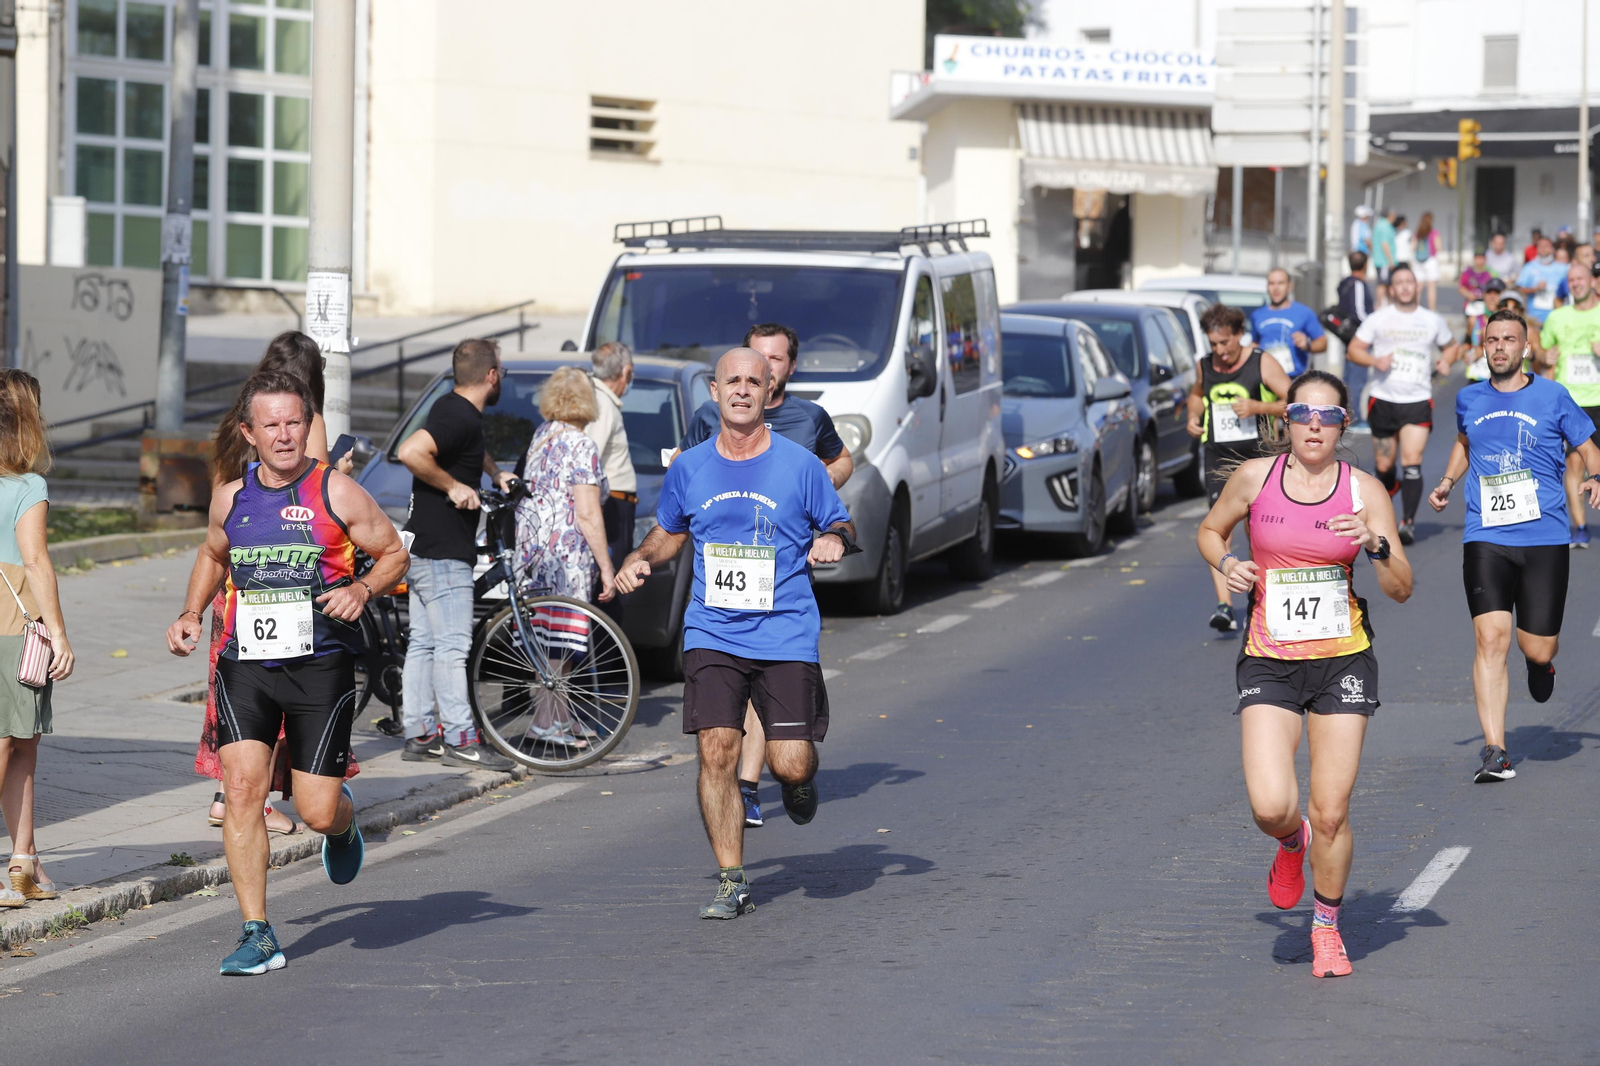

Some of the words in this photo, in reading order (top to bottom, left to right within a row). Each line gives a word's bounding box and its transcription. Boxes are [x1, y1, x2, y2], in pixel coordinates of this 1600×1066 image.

[970, 43, 1086, 62] CHURROS
[1003, 64, 1114, 82] PATATAS
[1122, 71, 1208, 87] FRITAS
[1508, 471, 1528, 483] HUELVA
[712, 491, 741, 503] VUELTA
[749, 492, 778, 511] HUELVA
[1491, 493, 1516, 512] 225
[285, 508, 310, 519] KIA
[281, 523, 313, 532] VEYSER
[715, 547, 737, 558] VUELTA
[738, 548, 744, 557] A
[744, 548, 770, 559] HUELVA
[715, 569, 747, 592] 443
[1271, 573, 1281, 583] 34
[1281, 571, 1308, 583] VUELTA
[1309, 571, 1316, 582] A
[1316, 569, 1342, 581] HUELVA
[271, 592, 277, 602] A
[278, 590, 306, 602] HUELVA
[1282, 597, 1321, 621] 147
[253, 617, 278, 641] 62
